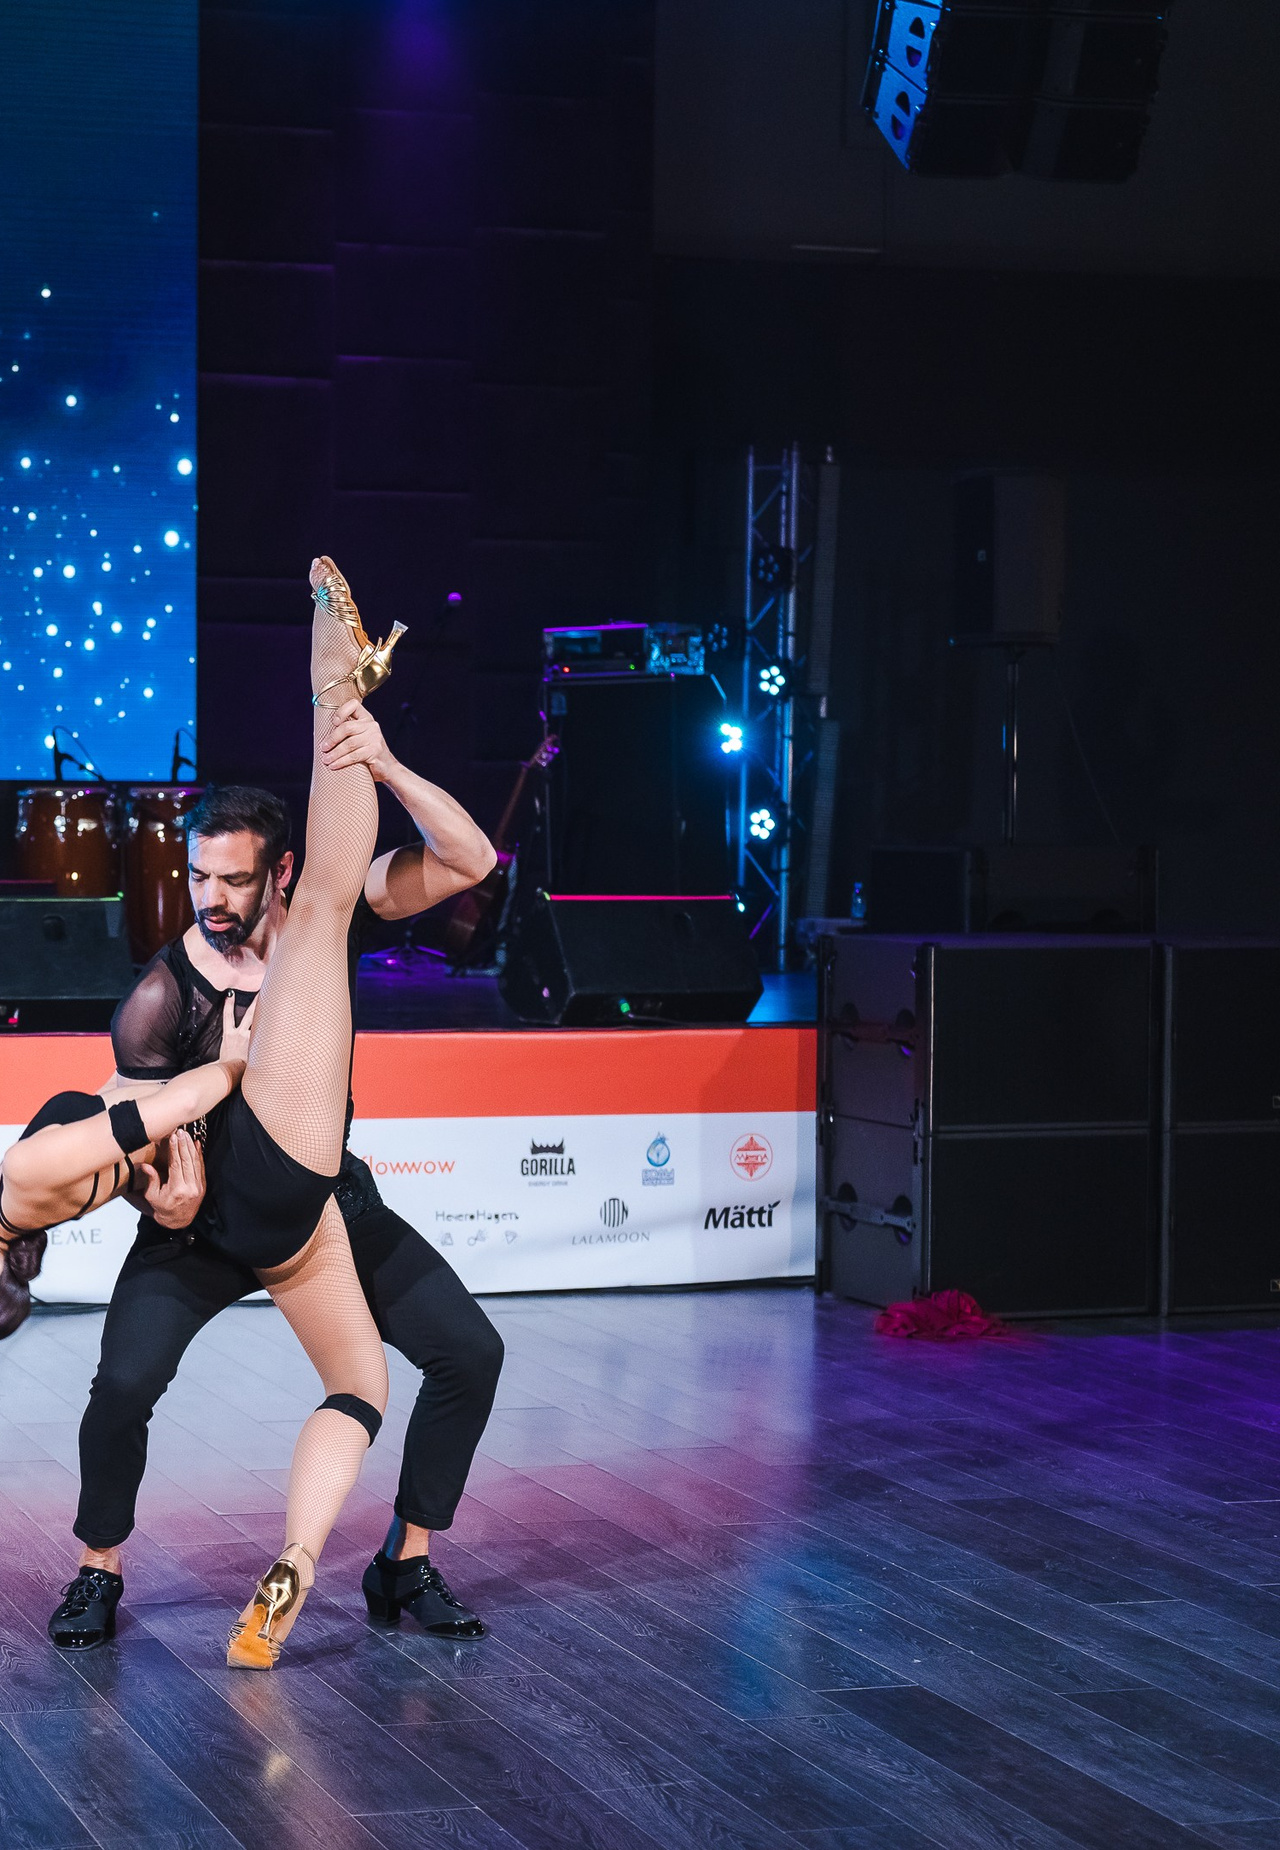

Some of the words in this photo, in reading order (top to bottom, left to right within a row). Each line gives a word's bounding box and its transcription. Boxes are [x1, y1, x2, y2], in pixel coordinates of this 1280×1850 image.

[362, 1155, 455, 1175] lowwow
[521, 1158, 576, 1176] GORILLA
[704, 1200, 781, 1230] Mätti
[571, 1231, 650, 1245] LALAMOON
